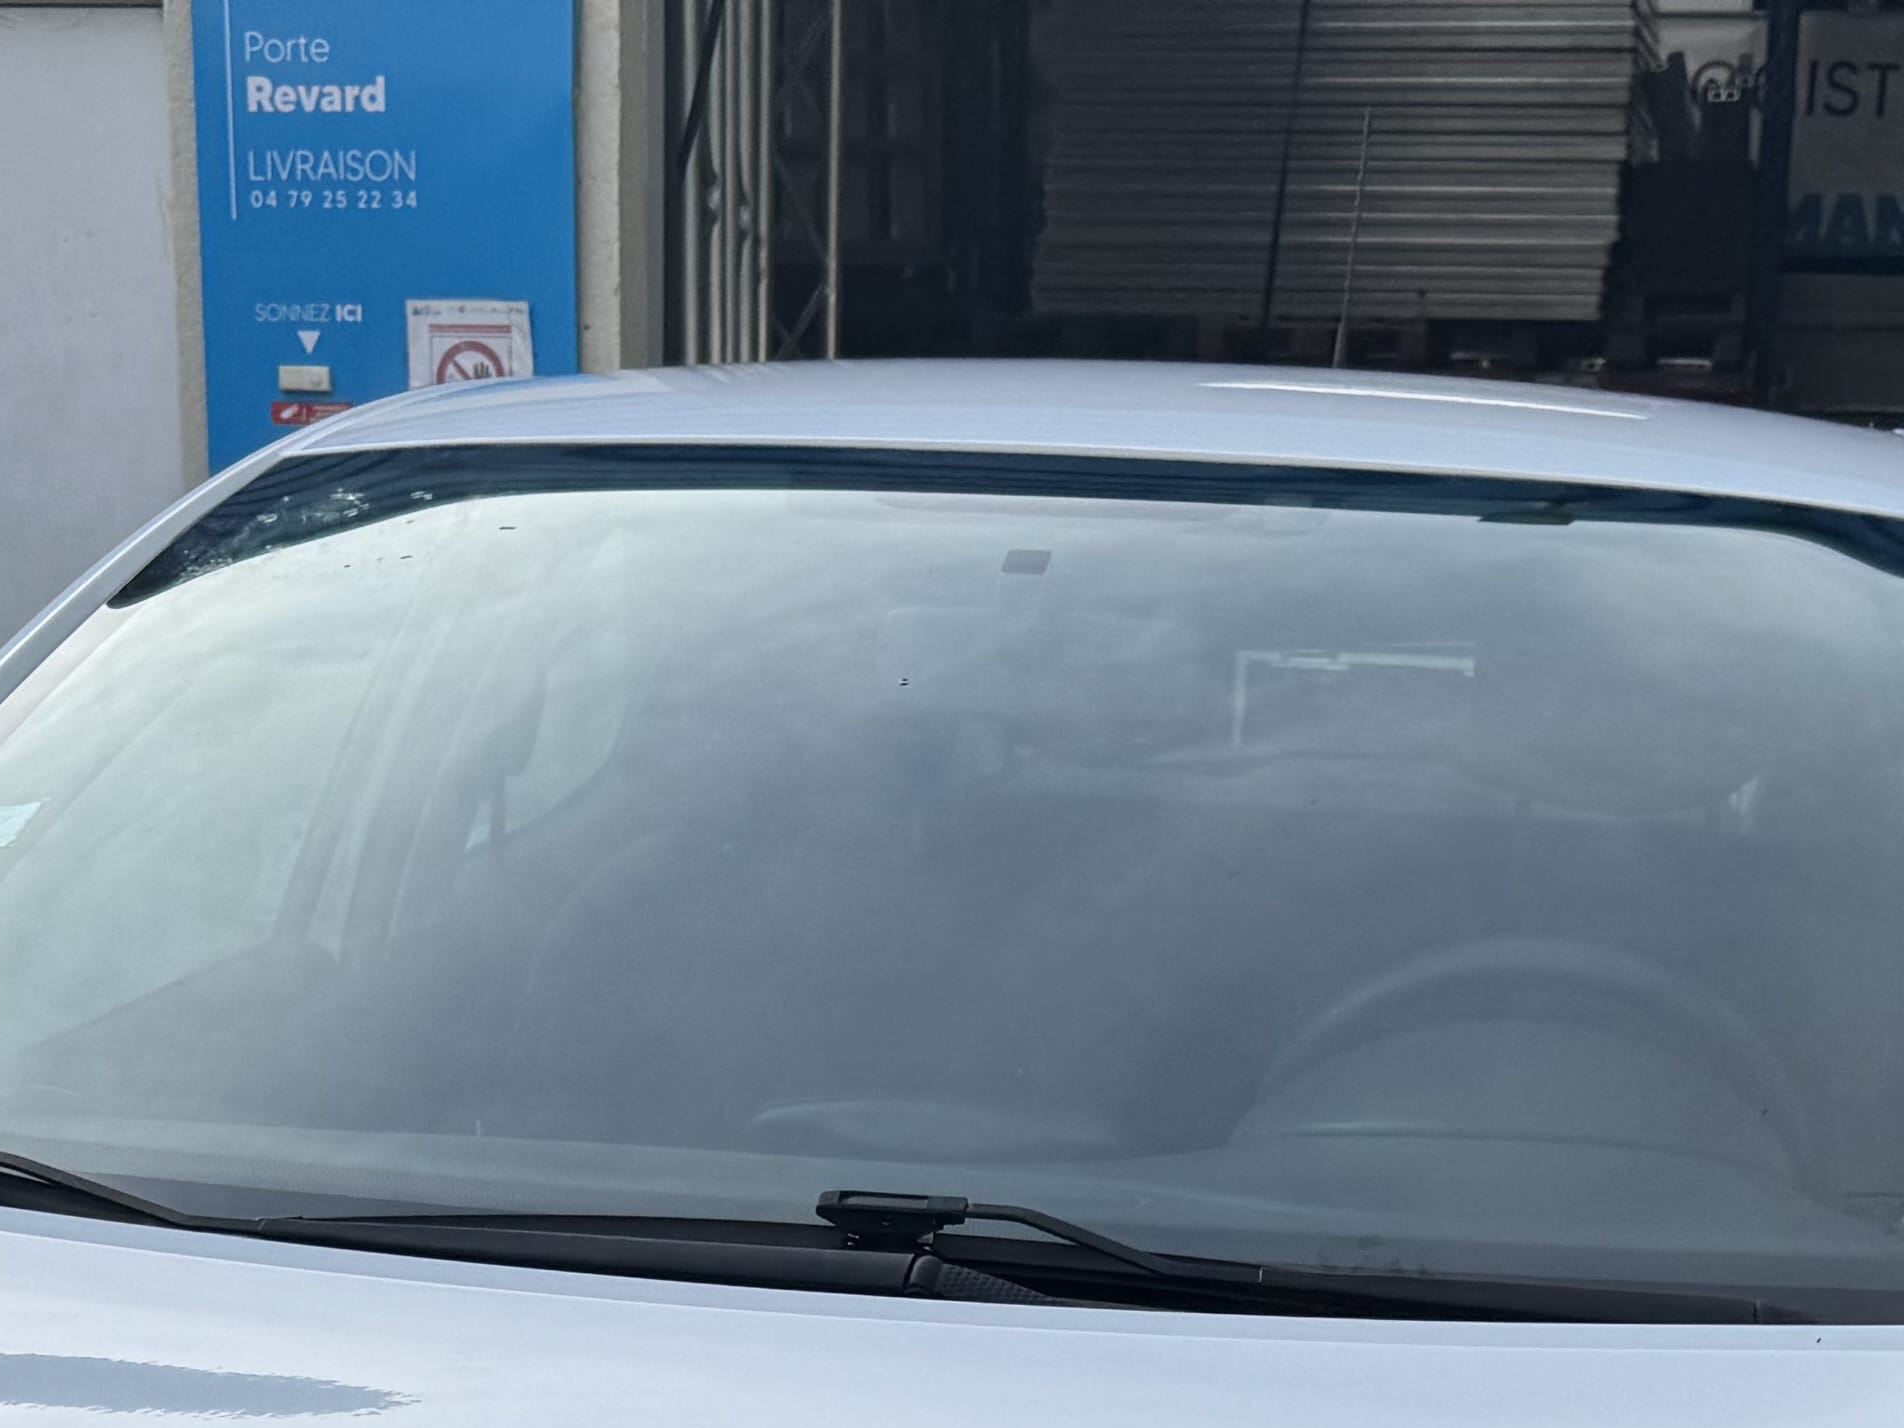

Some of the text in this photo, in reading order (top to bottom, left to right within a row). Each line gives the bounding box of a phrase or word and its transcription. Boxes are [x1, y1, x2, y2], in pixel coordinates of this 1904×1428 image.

[244, 31, 330, 63] Porte
[246, 76, 386, 113] Revard
[248, 149, 417, 183] LIVRAISON
[250, 190, 417, 208] 04 79 25 22 34
[255, 303, 363, 323] SONNEZ ICI
